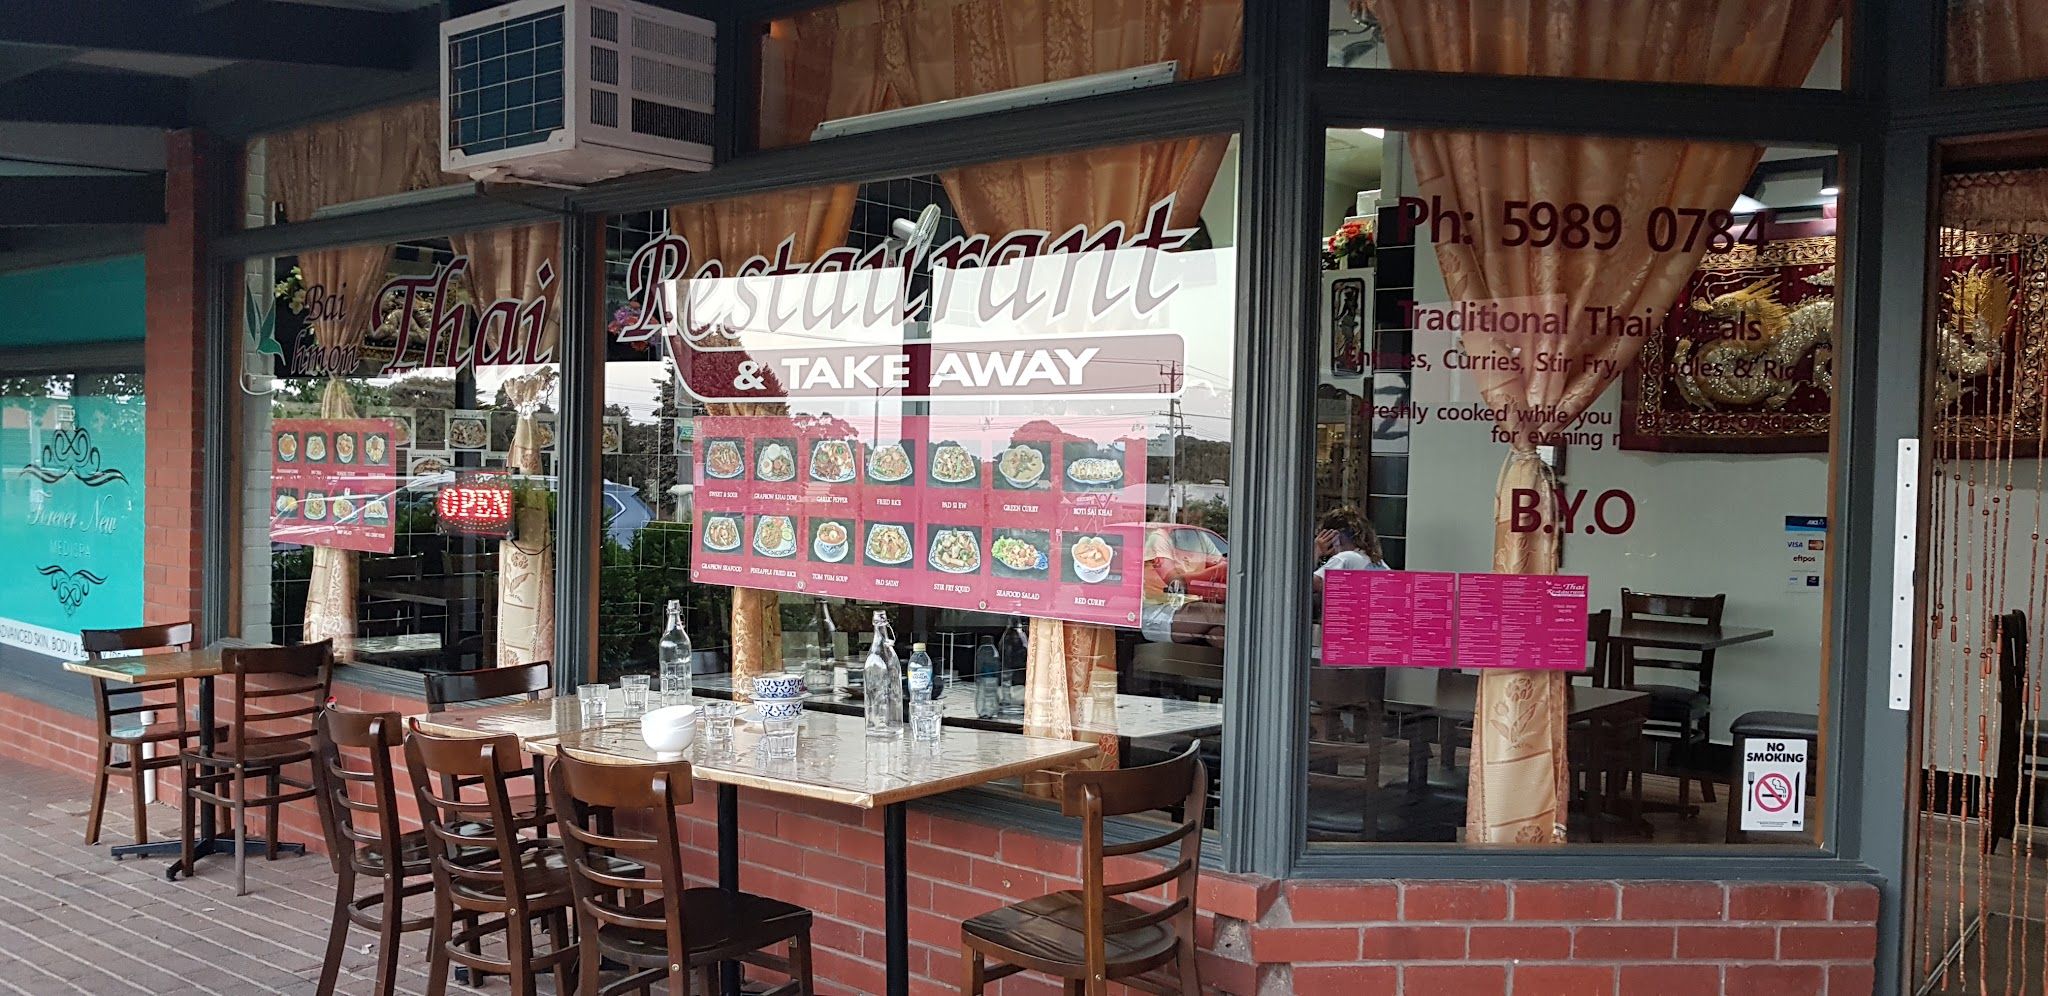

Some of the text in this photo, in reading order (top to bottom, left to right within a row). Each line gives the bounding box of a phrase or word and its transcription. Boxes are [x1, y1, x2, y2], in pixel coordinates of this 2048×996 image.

[1397, 195, 1770, 256] Ph: 5989 0784
[616, 190, 1200, 343] Restaurant
[304, 282, 348, 324] Bai
[369, 254, 556, 379] Thai
[1396, 300, 1763, 342] Traditional Thai eals
[733, 347, 1101, 391] & TAKE AWAY
[1442, 349, 1525, 374] Curries,
[1536, 351, 1572, 373] Stir
[1582, 354, 1621, 380] Fry,
[1733, 360, 1755, 379] &
[1764, 361, 1811, 382] Ric
[1436, 402, 1507, 422] cooked
[1518, 404, 1568, 424] while
[1576, 409, 1612, 427] you
[1490, 425, 1519, 443] for
[1528, 432, 1604, 451] evening
[440, 488, 512, 519] OPEN
[876, 498, 891, 506] FRIED
[1003, 504, 1039, 513] GREEN CURRY
[1510, 488, 1637, 535] B.Y.O
[1792, 554, 1816, 563] eftpos
[835, 575, 849, 583] SOUP
[996, 589, 1041, 600] SEAFOOD SALAD
[1074, 597, 1087, 605] RED
[0, 624, 33, 647] DVANCED
[51, 636, 72, 653] BODY
[73, 641, 79, 656] &
[1746, 752, 1805, 763] SMOKING
[1766, 742, 1786, 752] NO
